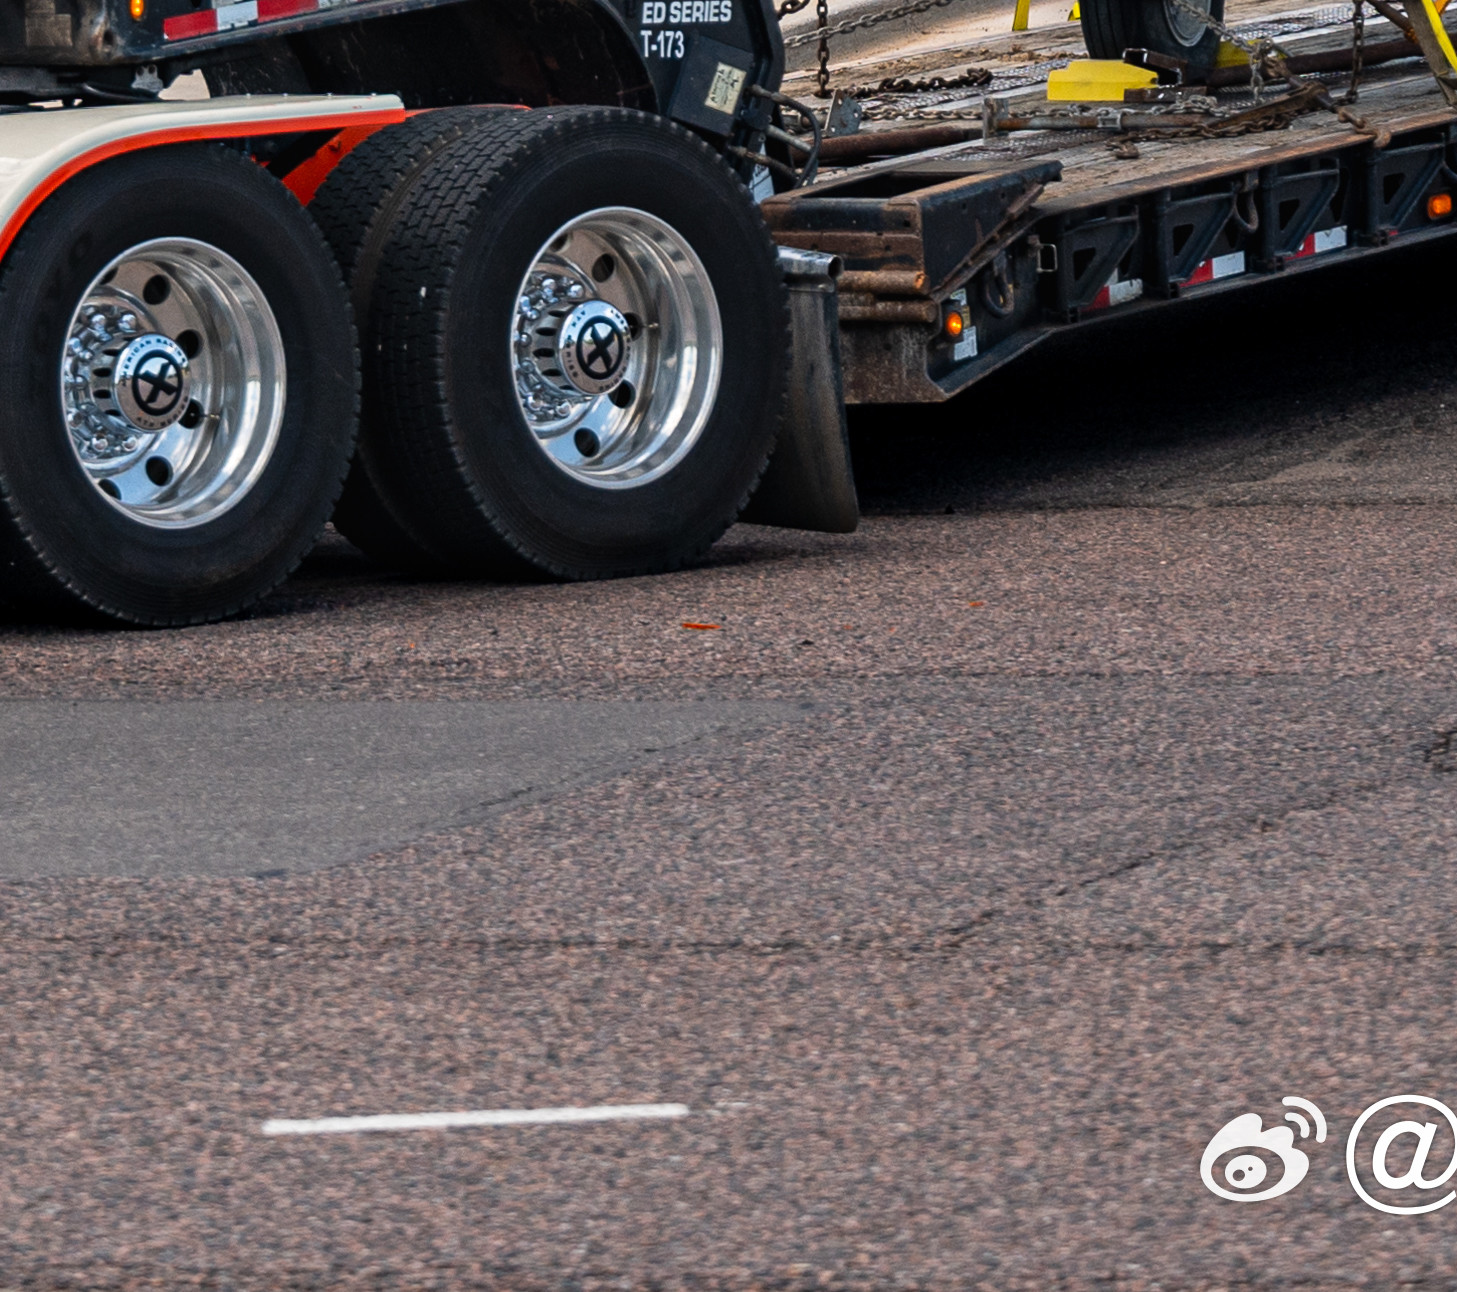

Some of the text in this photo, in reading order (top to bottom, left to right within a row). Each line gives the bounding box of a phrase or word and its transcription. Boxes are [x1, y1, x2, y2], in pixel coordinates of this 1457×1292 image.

[642, 0, 733, 24] ED SERIES
[640, 30, 685, 59] T-173
